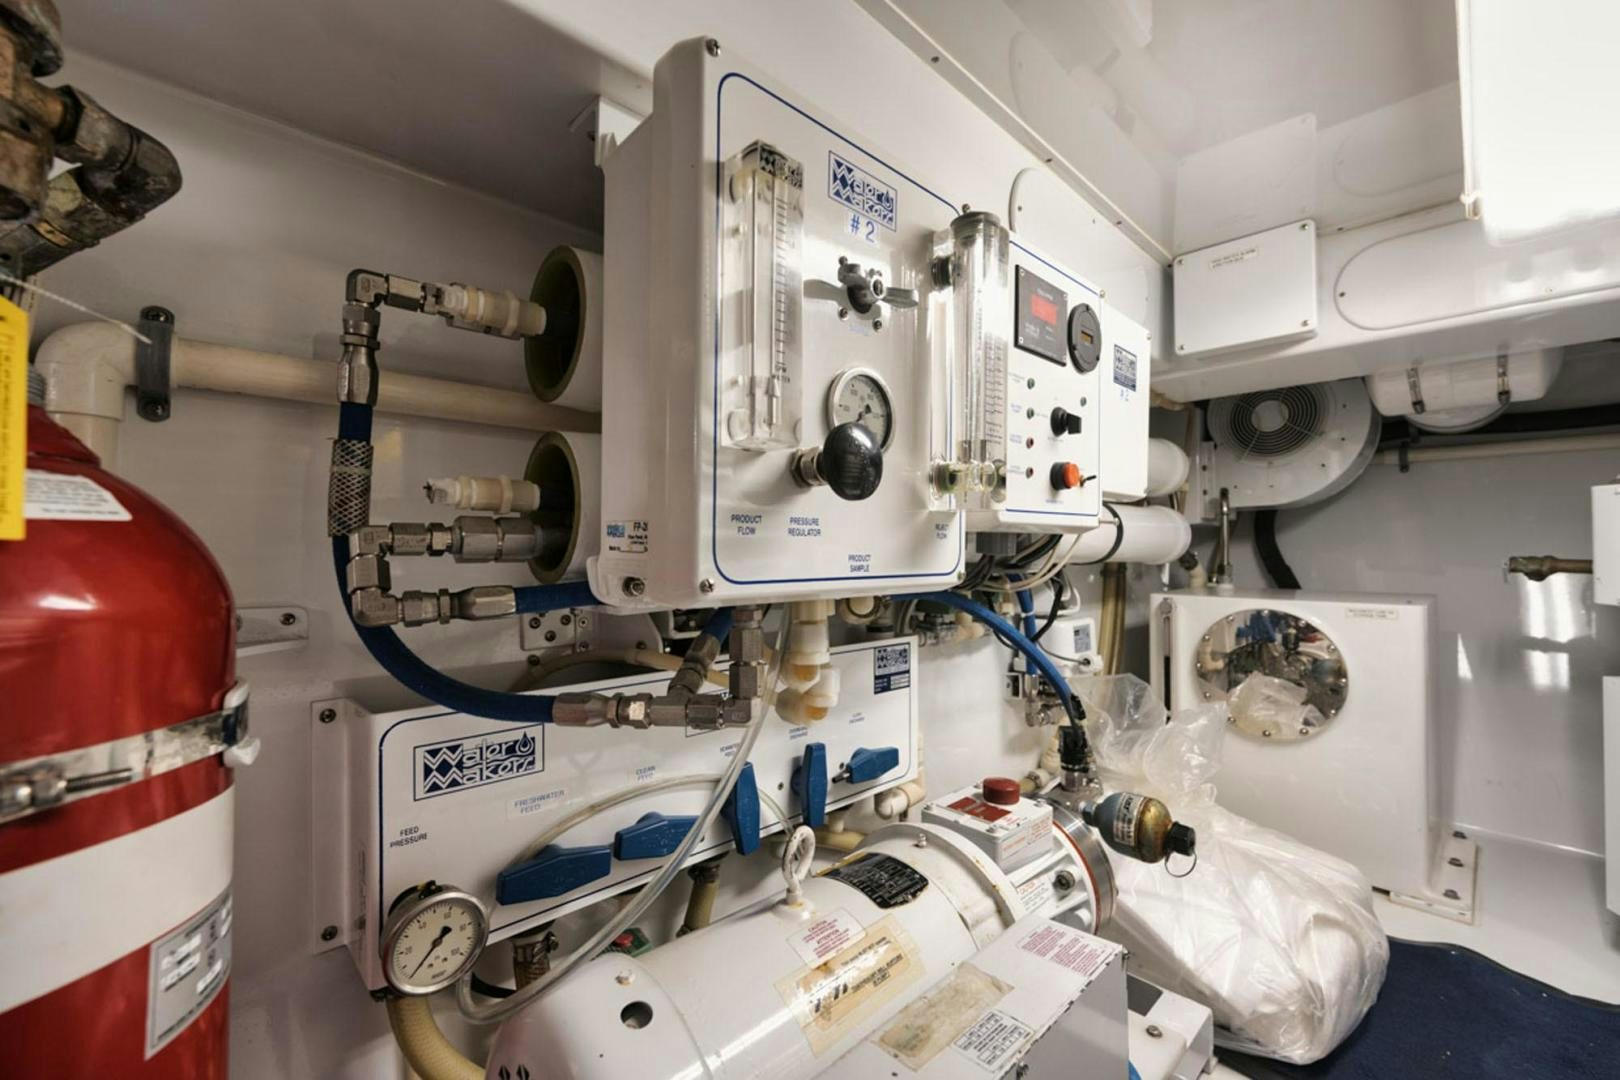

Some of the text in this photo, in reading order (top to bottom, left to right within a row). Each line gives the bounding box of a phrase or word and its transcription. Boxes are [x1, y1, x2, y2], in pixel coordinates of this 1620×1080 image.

[850, 213, 876, 243] # 2
[731, 513, 762, 524] PRODUCT
[789, 516, 820, 526] PRESSURE
[737, 526, 756, 535] FLOW
[788, 527, 821, 537] REGULATOR
[847, 553, 871, 562] PRODUCT
[849, 564, 870, 572] SAMPLE
[514, 789, 565, 808] FRESHWATER
[400, 825, 419, 837] FEED
[389, 832, 427, 848] PRESSURE
